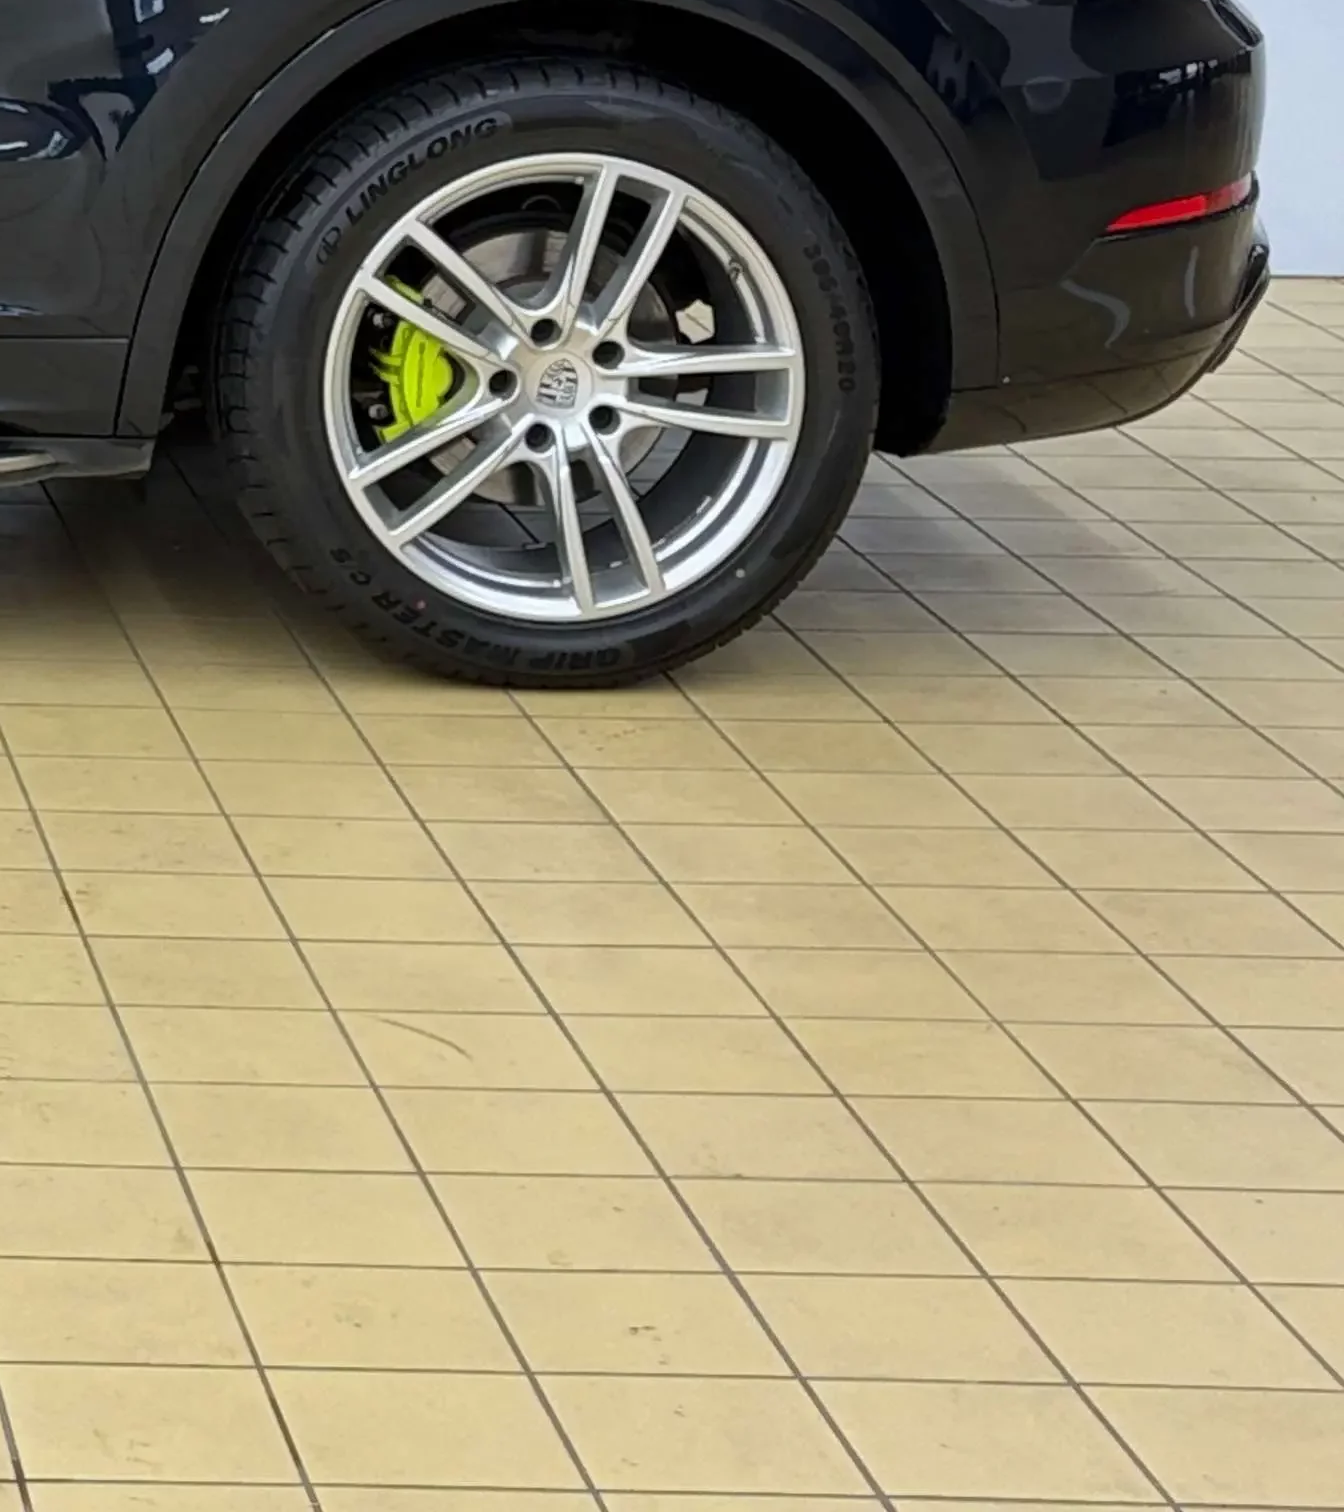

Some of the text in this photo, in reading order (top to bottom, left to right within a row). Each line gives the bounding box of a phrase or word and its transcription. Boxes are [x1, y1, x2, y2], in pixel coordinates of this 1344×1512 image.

[345, 118, 498, 225] LINGLONG
[372, 590, 520, 665] MASTER
[529, 648, 621, 669] GRIP
